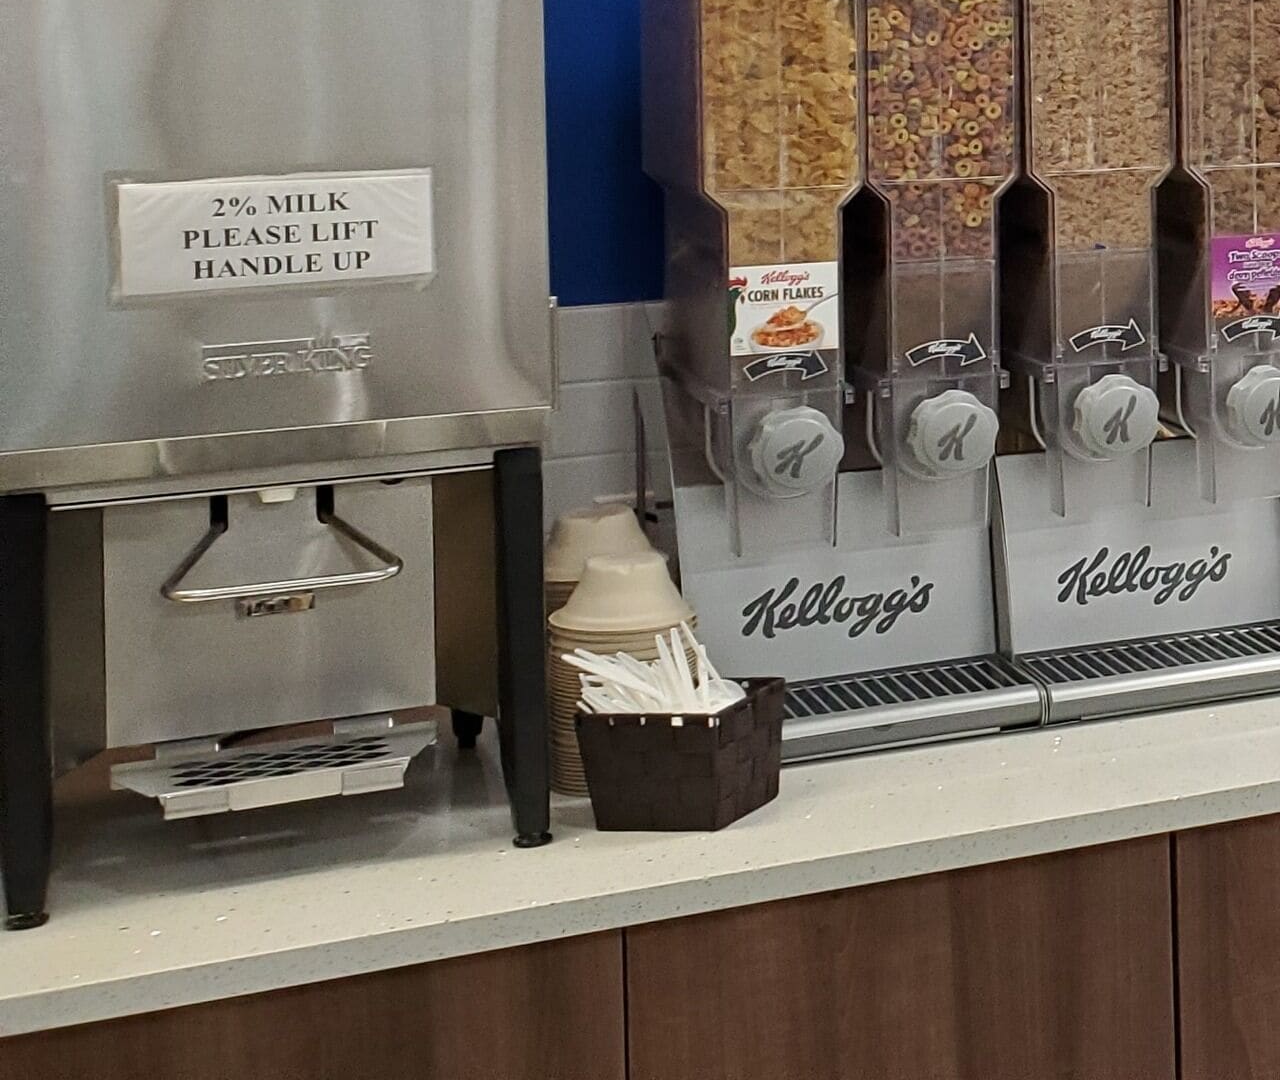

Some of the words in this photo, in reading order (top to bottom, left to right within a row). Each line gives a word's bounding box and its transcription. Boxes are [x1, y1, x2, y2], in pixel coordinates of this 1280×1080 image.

[211, 196, 257, 217] 2%
[266, 191, 350, 215] MILK
[183, 223, 301, 250] PLEASE
[312, 220, 379, 242] LIFT
[193, 253, 323, 280] HANDLE
[334, 251, 371, 271] UP
[761, 271, 810, 285] Kellogg's
[748, 287, 780, 303] CORN
[783, 286, 824, 301] FLAKES
[1103, 394, 1137, 445] K
[937, 413, 978, 461] K
[1056, 545, 1232, 606] Kellogg's
[741, 575, 935, 638] Kellogg's
